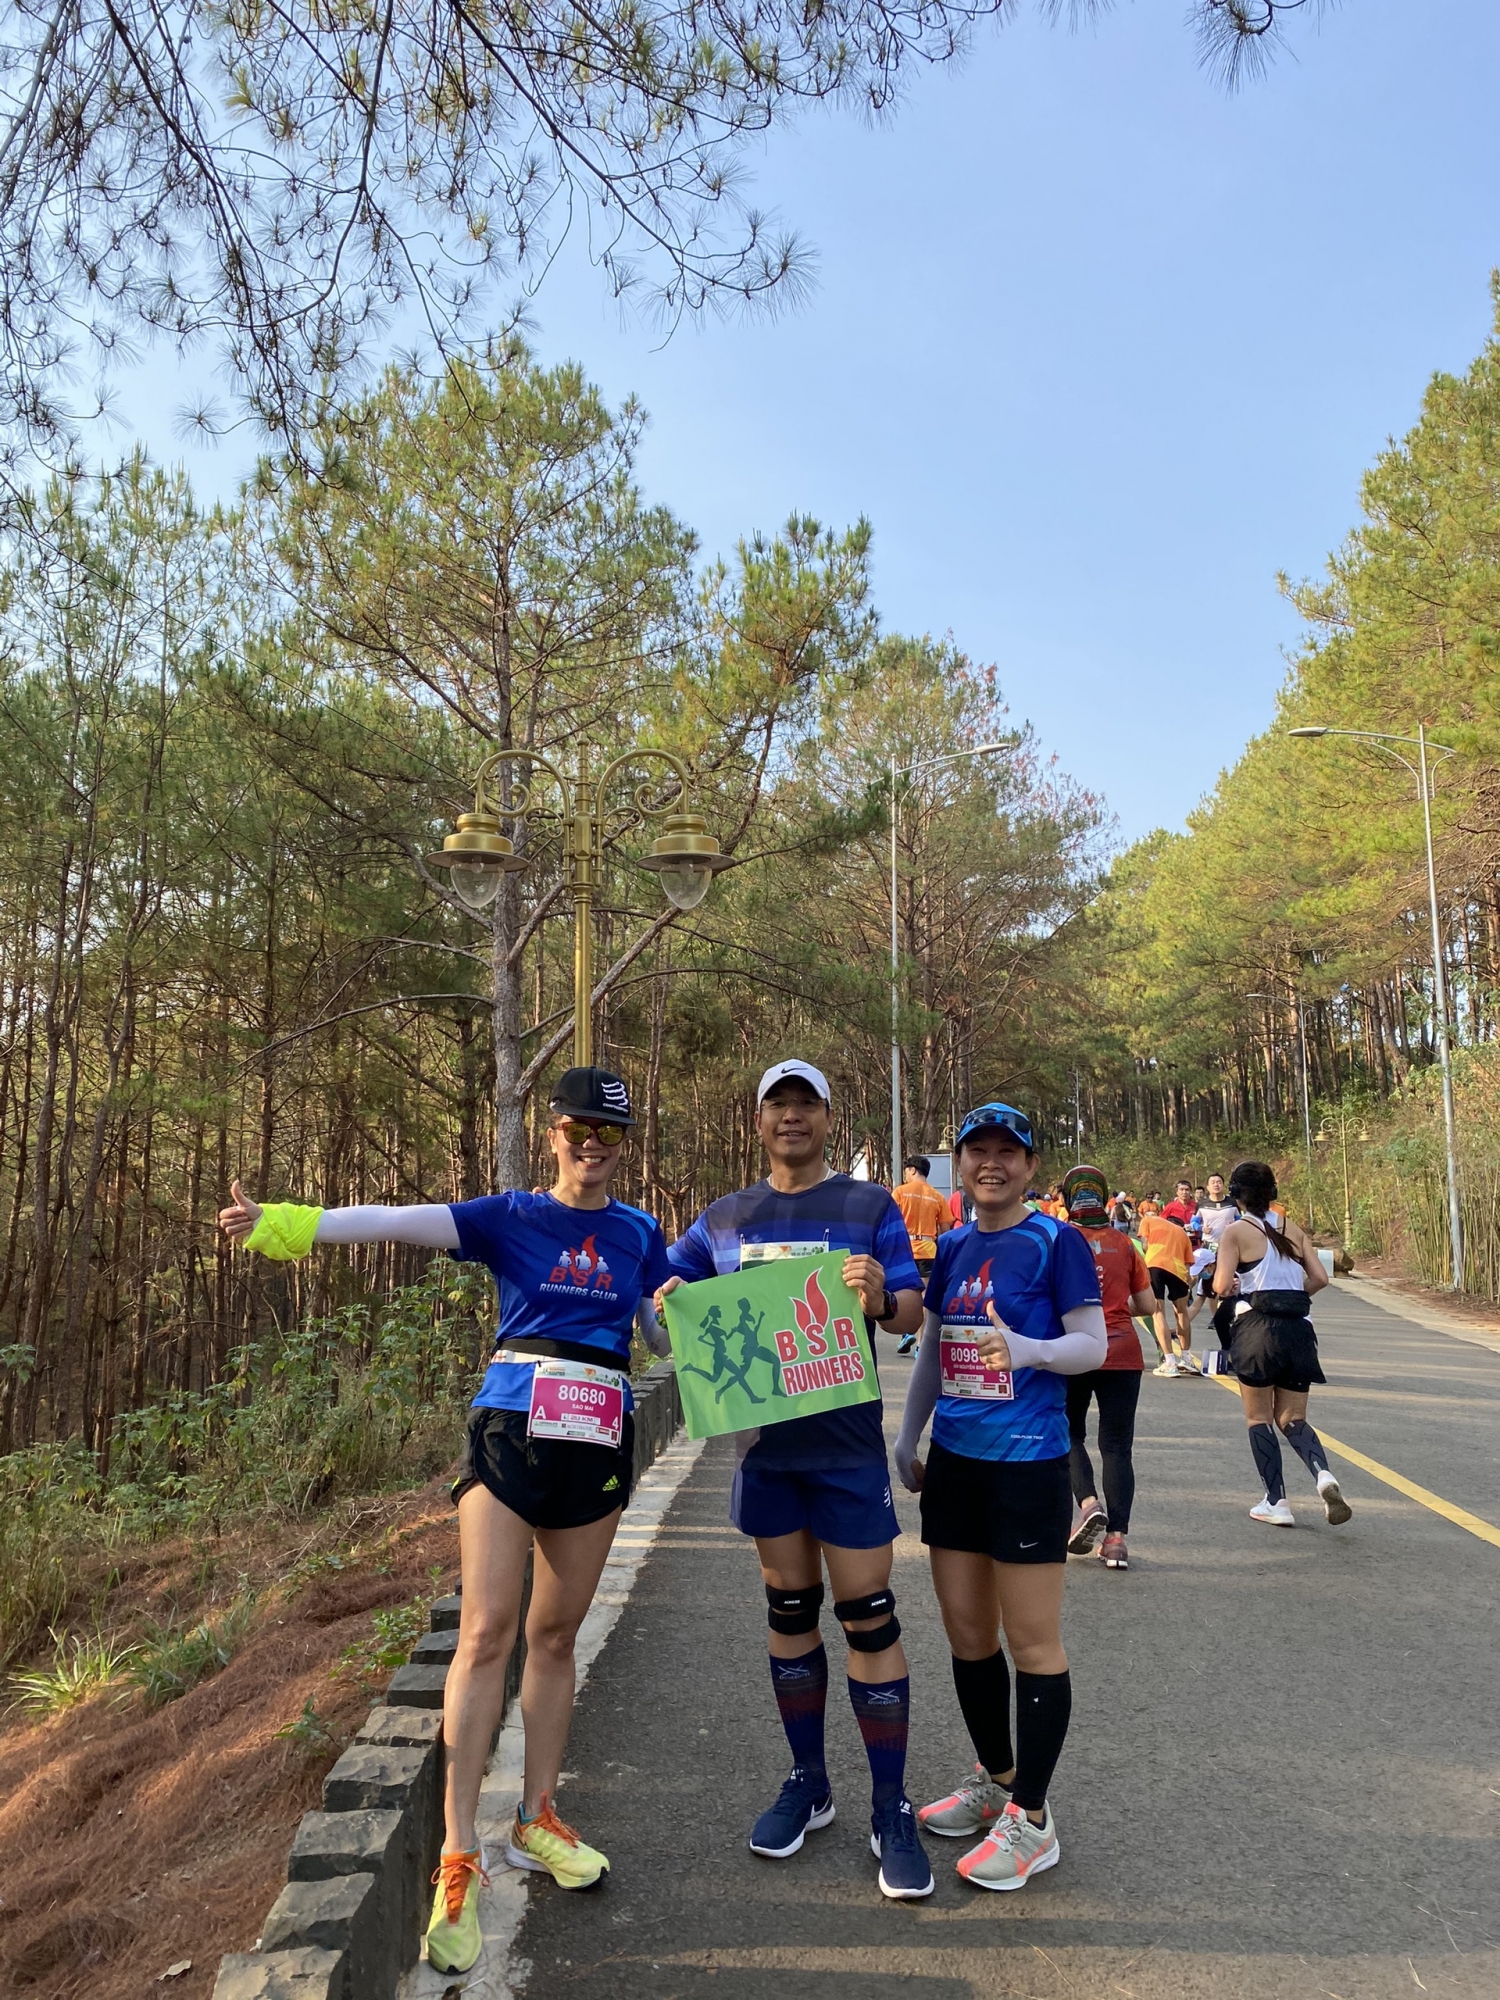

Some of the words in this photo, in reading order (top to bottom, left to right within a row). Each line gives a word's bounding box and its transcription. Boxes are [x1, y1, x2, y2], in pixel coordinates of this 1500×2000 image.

[539, 1283, 589, 1297] RUNNERS
[590, 1289, 618, 1301] CLUB
[950, 1347, 979, 1363] 8098
[781, 1351, 865, 1396] RUNNERS
[943, 1367, 949, 1380] A
[998, 1371, 1008, 1383] 5
[558, 1385, 606, 1406] 80680
[534, 1405, 546, 1420] A
[572, 1403, 583, 1411] SAO
[612, 1416, 619, 1430] 4
